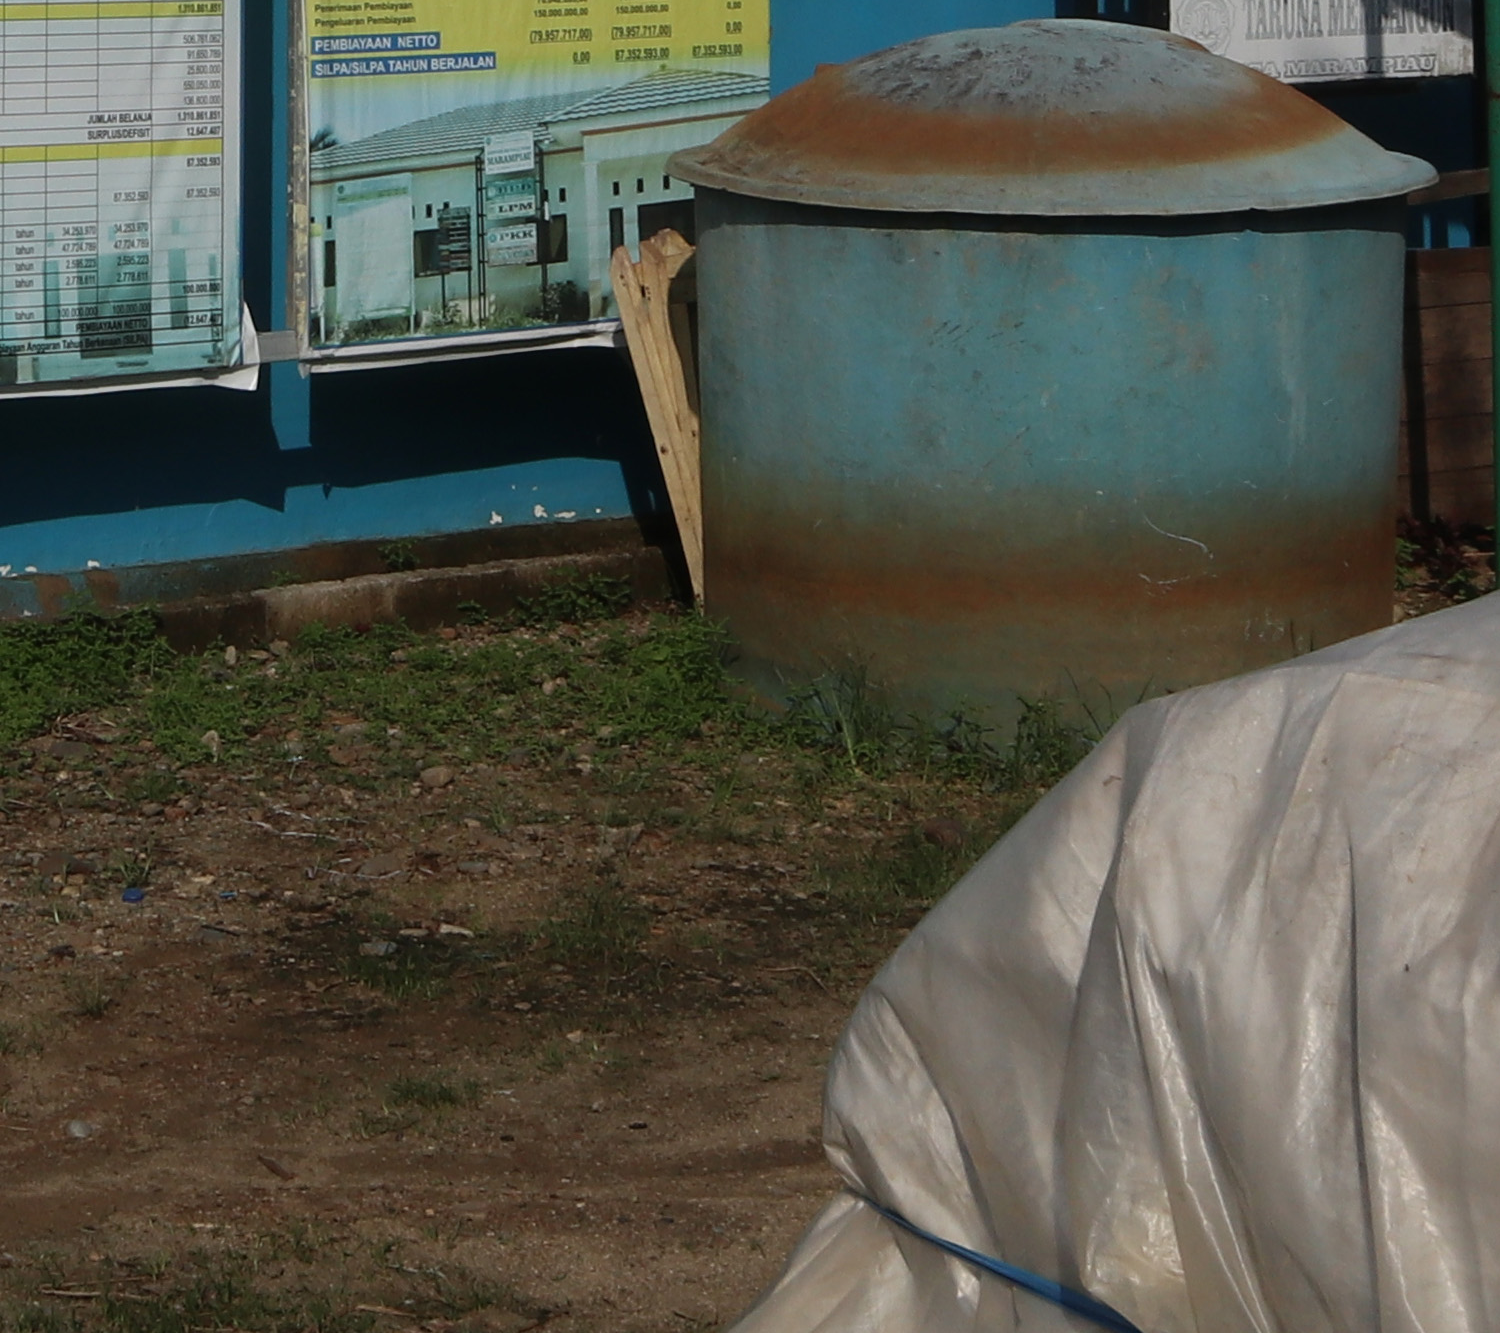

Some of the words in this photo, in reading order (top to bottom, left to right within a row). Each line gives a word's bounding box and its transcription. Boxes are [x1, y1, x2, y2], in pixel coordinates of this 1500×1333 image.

[315, 2, 363, 13] Penerimaan
[364, 0, 413, 12] Pembiayaan
[315, 16, 365, 28] Pengeluaran
[366, 14, 416, 26] Pembiayaan
[315, 36, 391, 52] PEMBIAYAAN
[398, 34, 437, 49] NETTO
[388, 57, 428, 72] TAHUN
[431, 55, 494, 71] BERJALAN
[1282, 53, 1437, 78] MARAMPIAU
